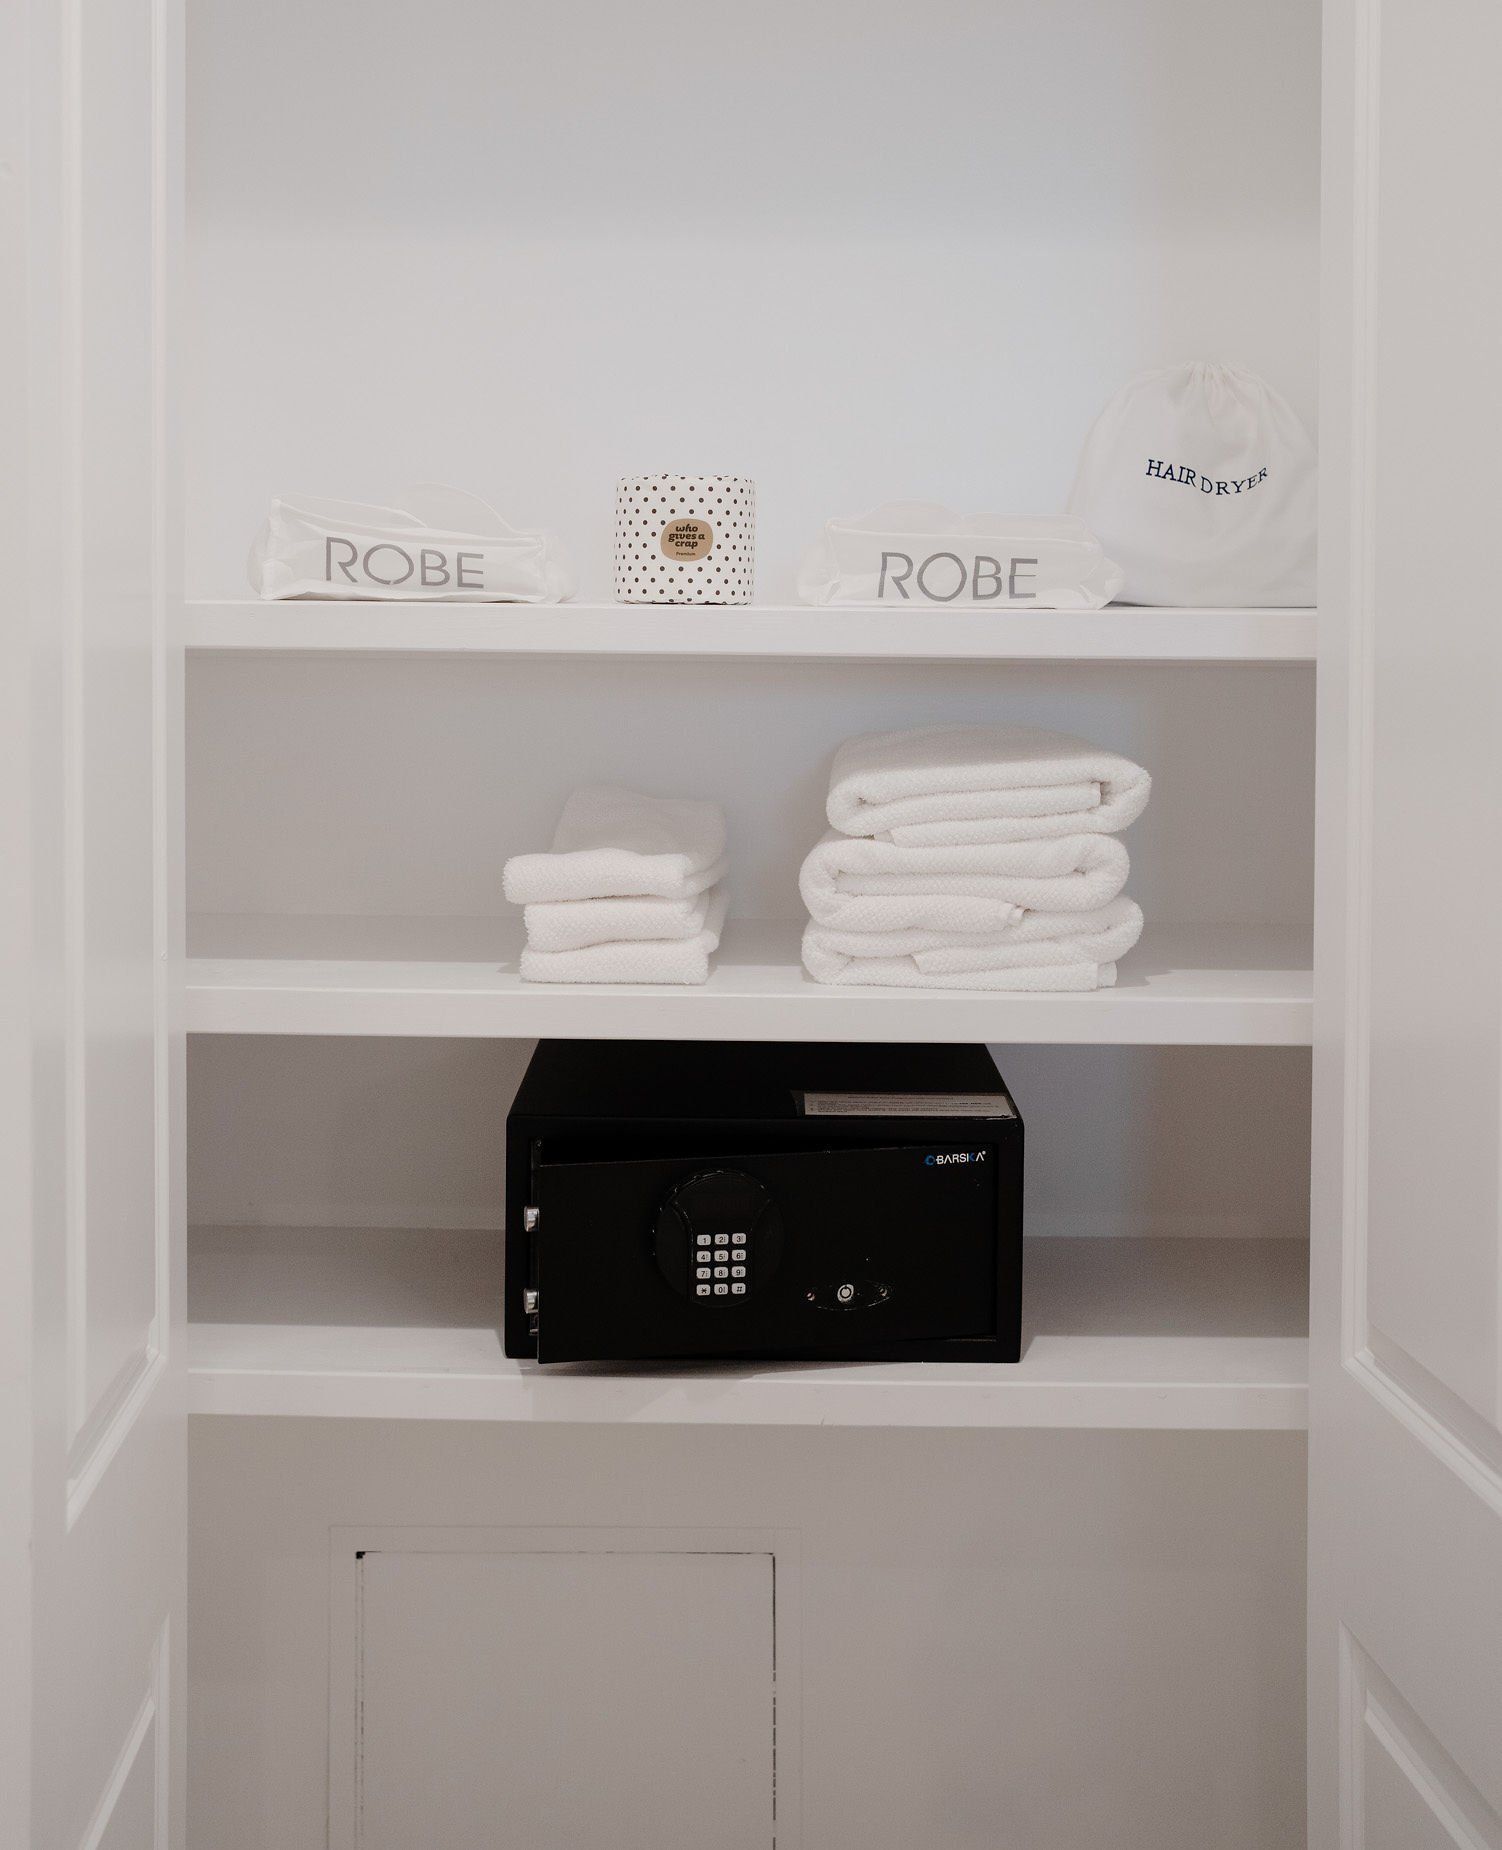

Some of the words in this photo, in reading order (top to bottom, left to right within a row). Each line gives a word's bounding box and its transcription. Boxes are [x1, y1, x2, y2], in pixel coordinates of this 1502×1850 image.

[1145, 458, 1197, 488] HAIR
[1200, 467, 1268, 496] DRYER
[668, 533, 697, 542] gives
[675, 523, 698, 532] who
[675, 540, 698, 549] crap
[325, 536, 485, 589] ROBE
[876, 551, 1039, 602] ROBE
